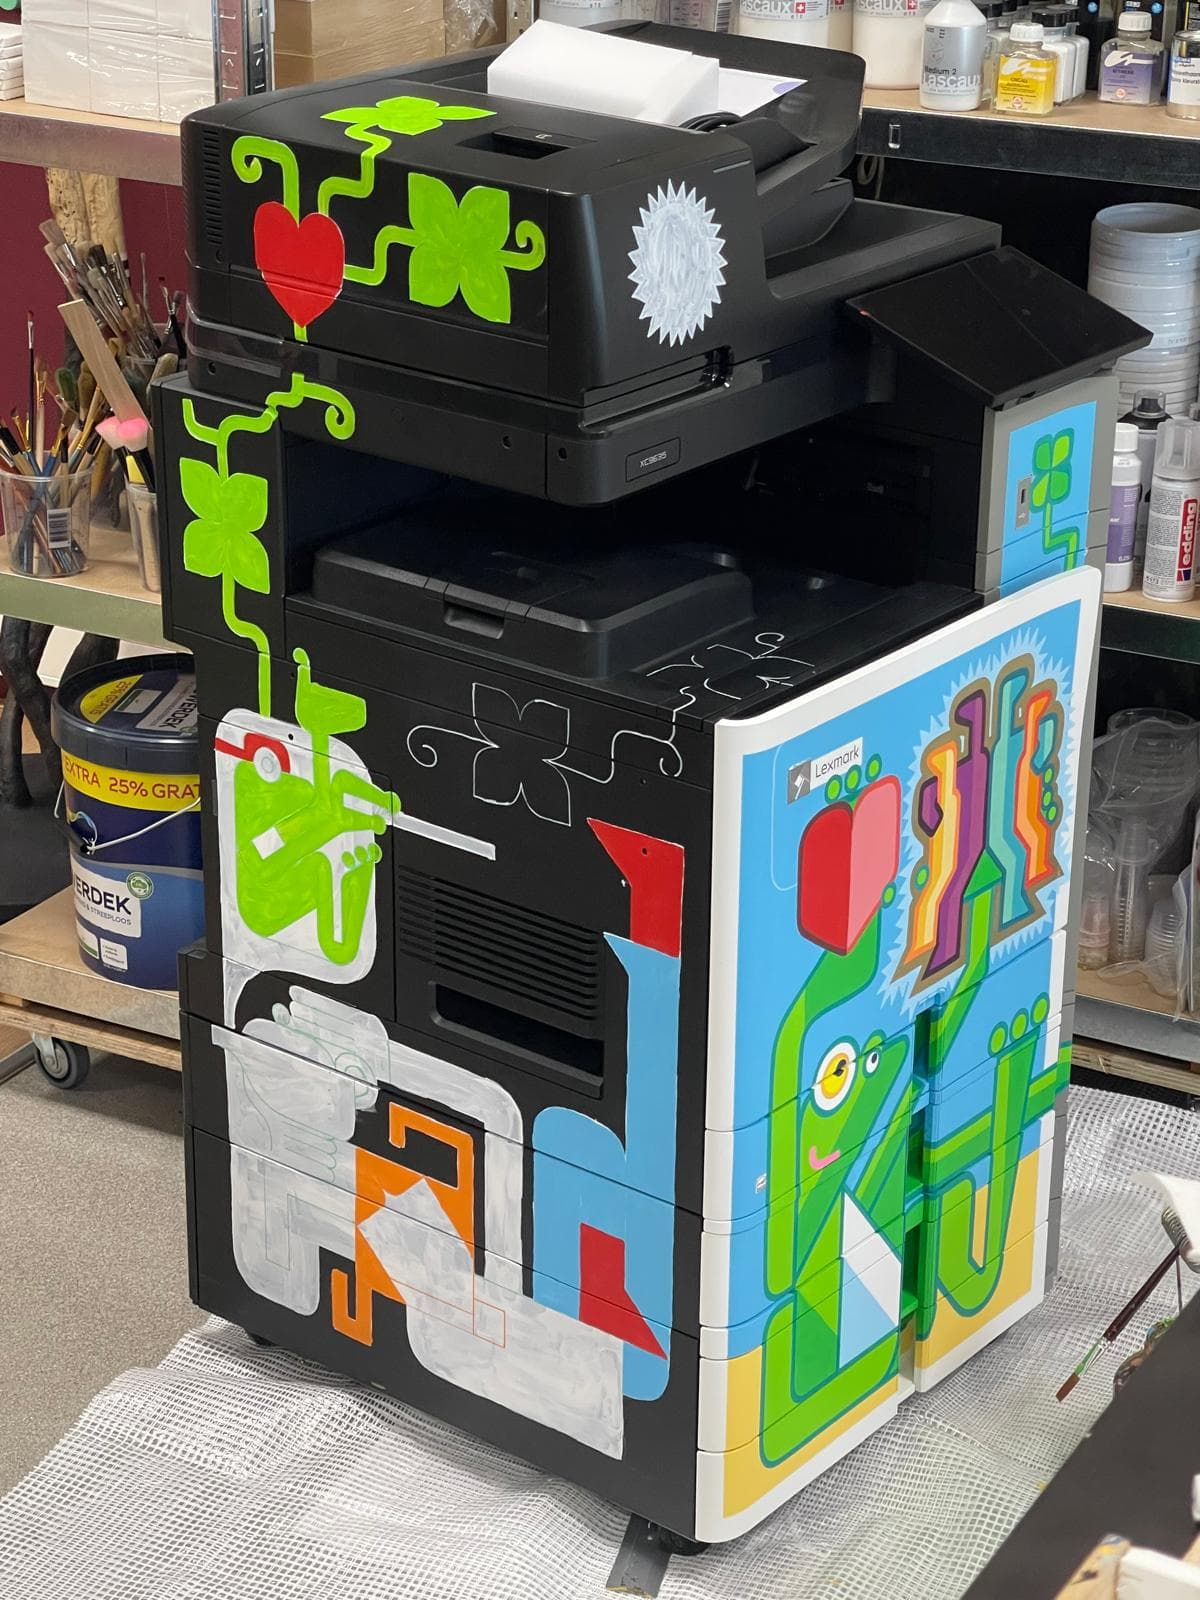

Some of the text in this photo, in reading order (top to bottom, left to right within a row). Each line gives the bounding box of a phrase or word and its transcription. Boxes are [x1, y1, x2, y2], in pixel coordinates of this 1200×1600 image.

[1183, 503, 1197, 566] edding
[64, 756, 101, 788] EXTRA
[108, 776, 148, 797] 25%
[815, 745, 859, 778] Lexmark
